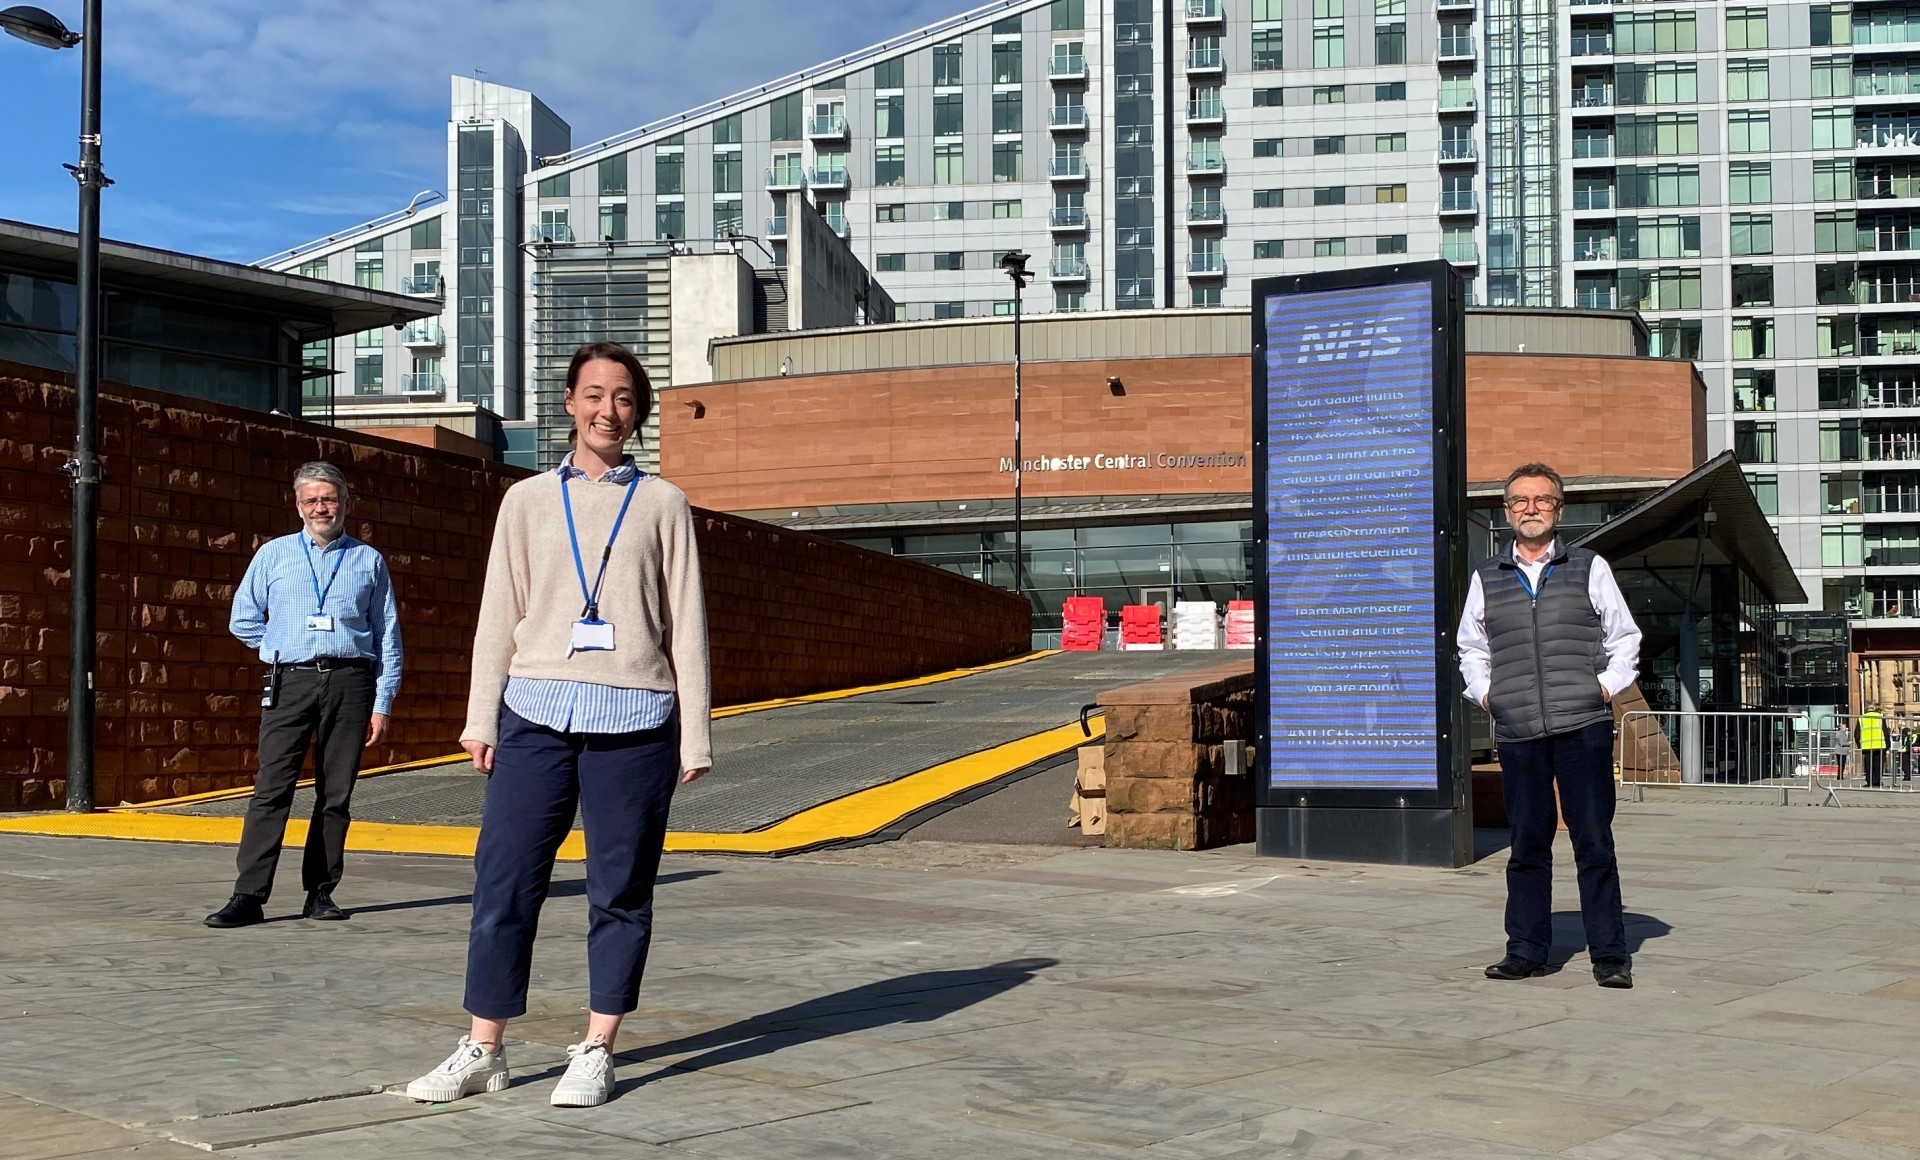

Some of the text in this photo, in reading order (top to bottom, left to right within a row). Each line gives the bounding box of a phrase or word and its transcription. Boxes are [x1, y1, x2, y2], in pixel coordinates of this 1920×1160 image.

[1297, 316, 1405, 364] NHS
[999, 451, 1247, 472] Mnchester Central Convention
